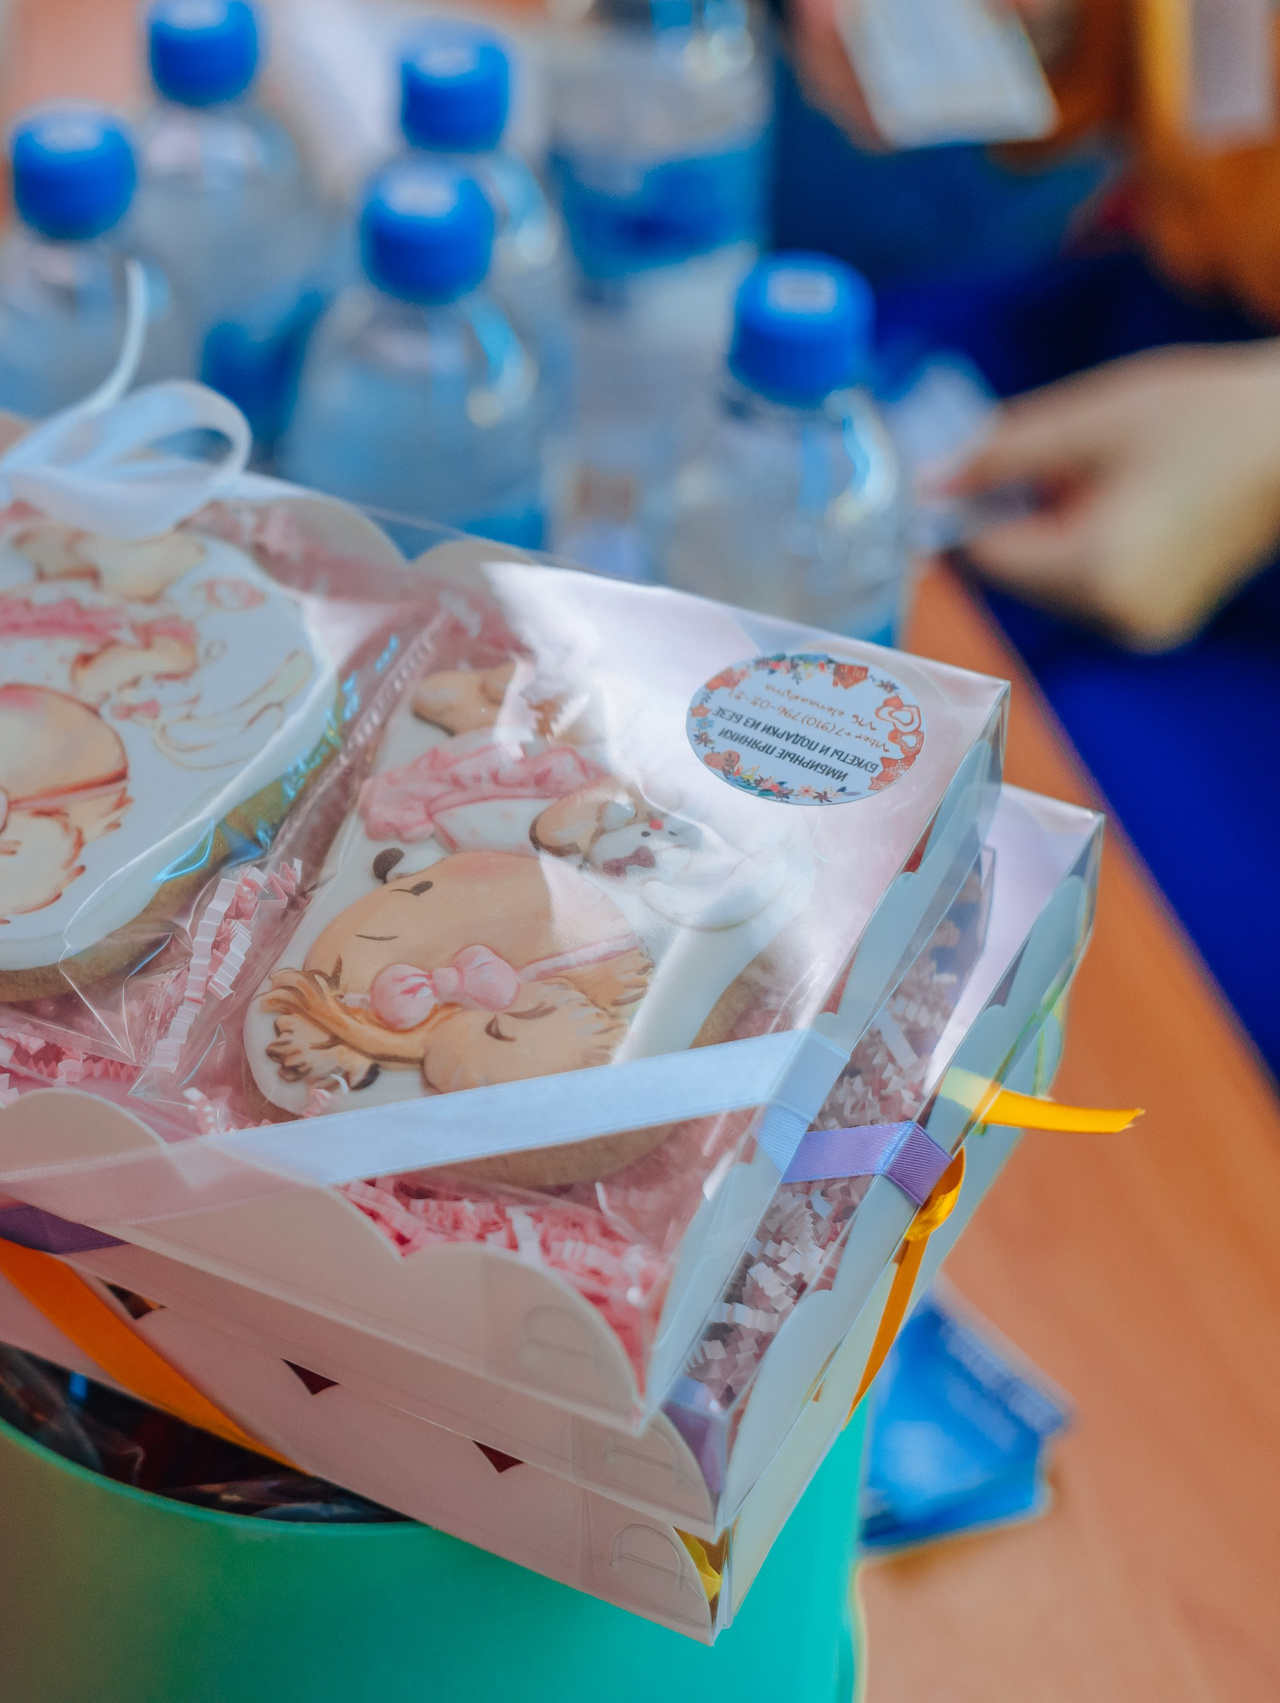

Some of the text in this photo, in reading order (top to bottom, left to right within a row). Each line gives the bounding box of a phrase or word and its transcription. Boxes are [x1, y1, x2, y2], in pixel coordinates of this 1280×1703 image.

[712, 706, 879, 773] БУКЕТЫ И ПОДАРКИ ИЗ БЕЗЕ
[718, 727, 848, 782] ИМБИРНЫЕ ПРЯНИКИ
[855, 734, 890, 753] Viber
